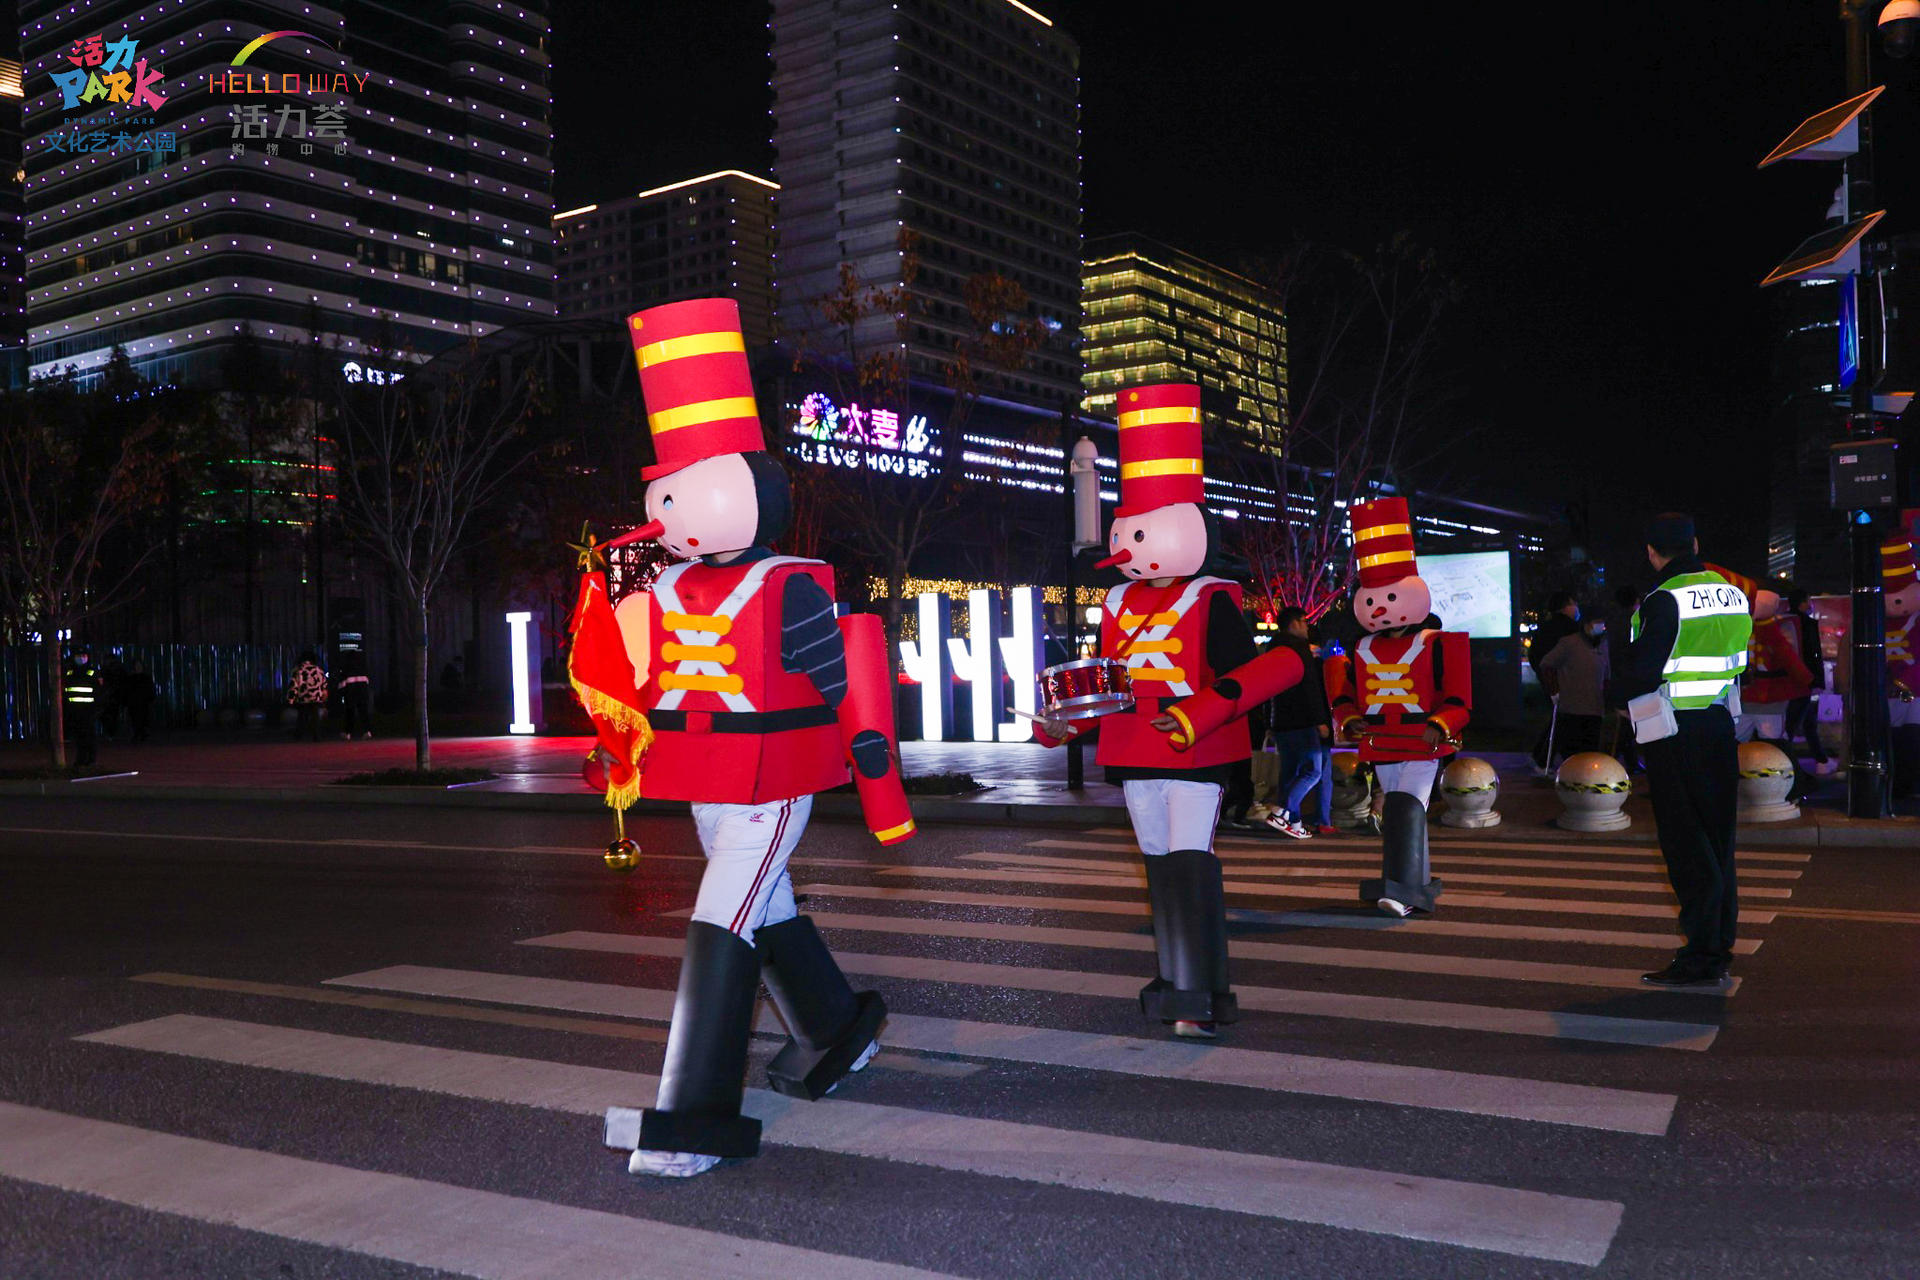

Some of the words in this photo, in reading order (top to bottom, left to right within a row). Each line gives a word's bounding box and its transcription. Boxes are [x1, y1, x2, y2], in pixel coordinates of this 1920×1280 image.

[801, 441, 861, 469] LIVE
[865, 450, 930, 480] HOUSE
[1687, 589, 1716, 609] ZHI
[1716, 588, 1742, 607] QIN
